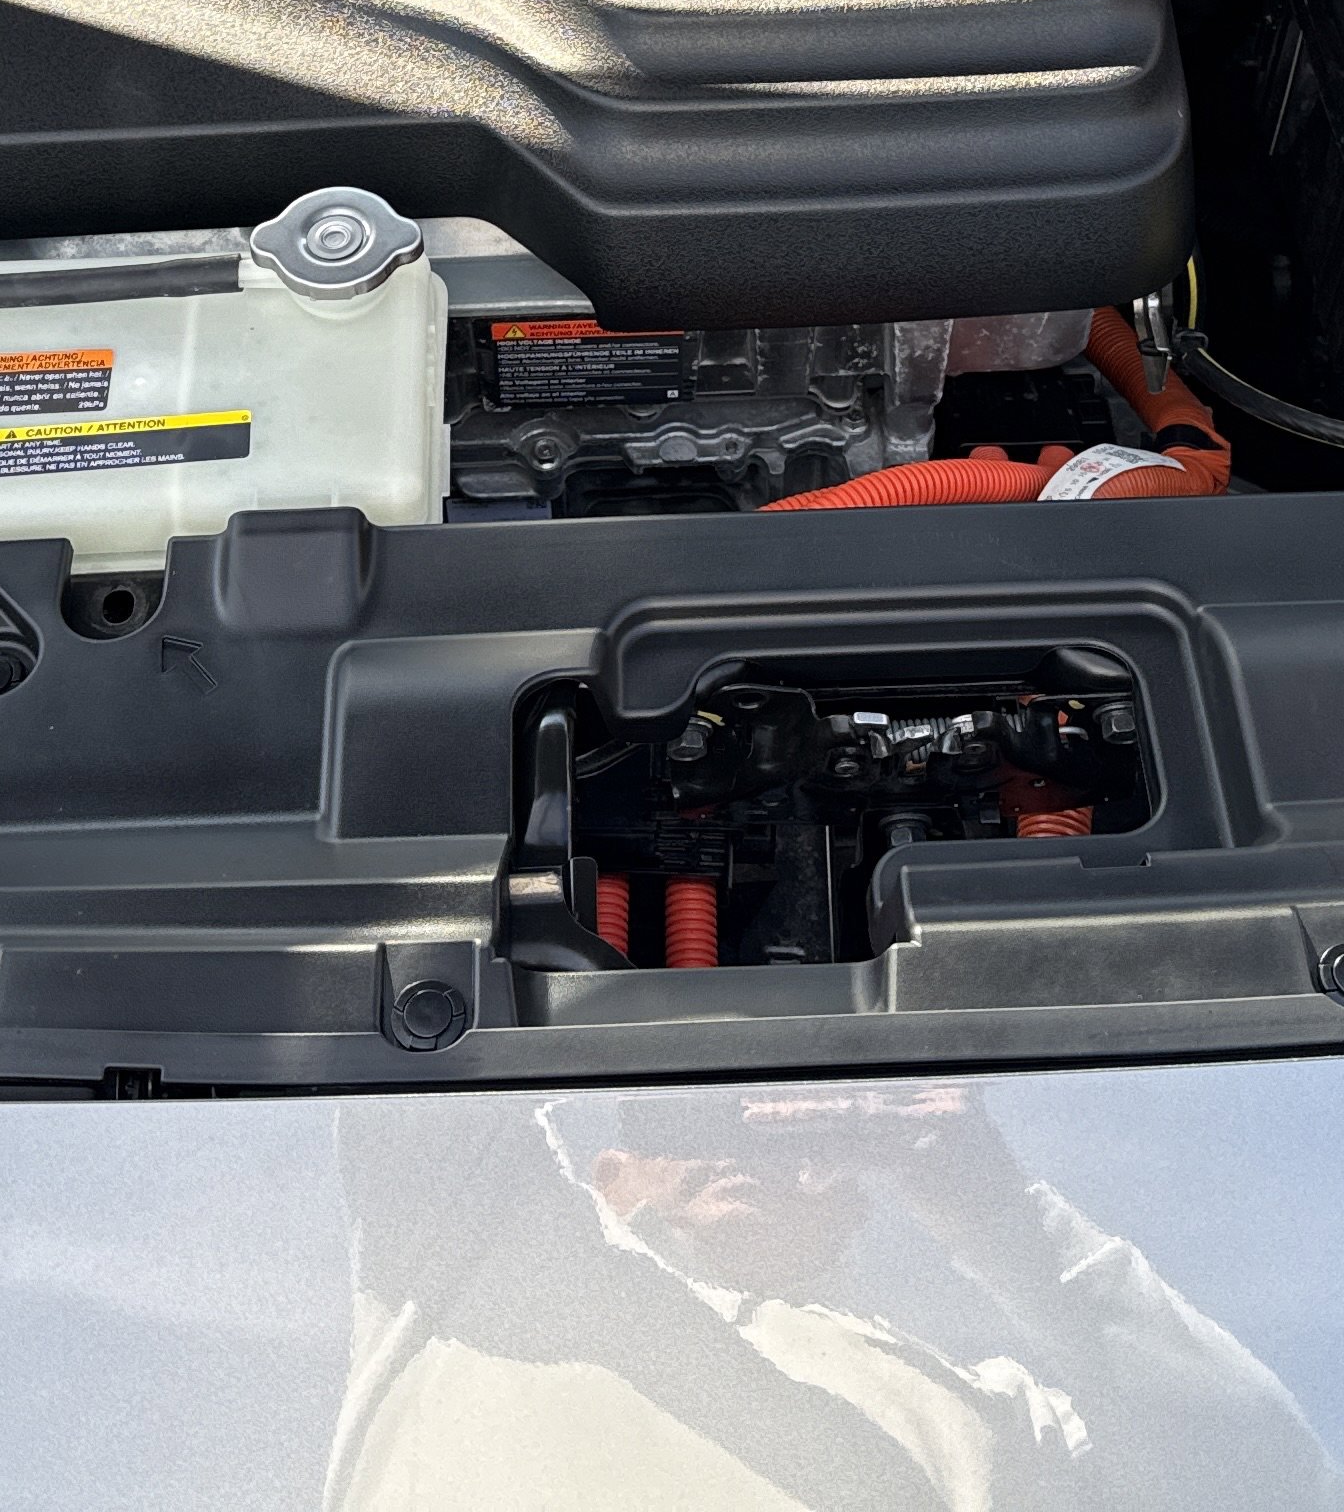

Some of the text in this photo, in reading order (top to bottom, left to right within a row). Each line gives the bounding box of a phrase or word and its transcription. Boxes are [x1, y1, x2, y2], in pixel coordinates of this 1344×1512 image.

[529, 323, 571, 331] WARNING
[529, 329, 573, 337] ACHTUNG
[30, 352, 79, 363] ACHTUNG
[26, 425, 82, 438] CAUTION
[96, 418, 166, 433] ATTENTION
[24, 440, 42, 448] ANY
[82, 451, 104, 460] TOUT
[89, 457, 141, 467] APPROCHER
